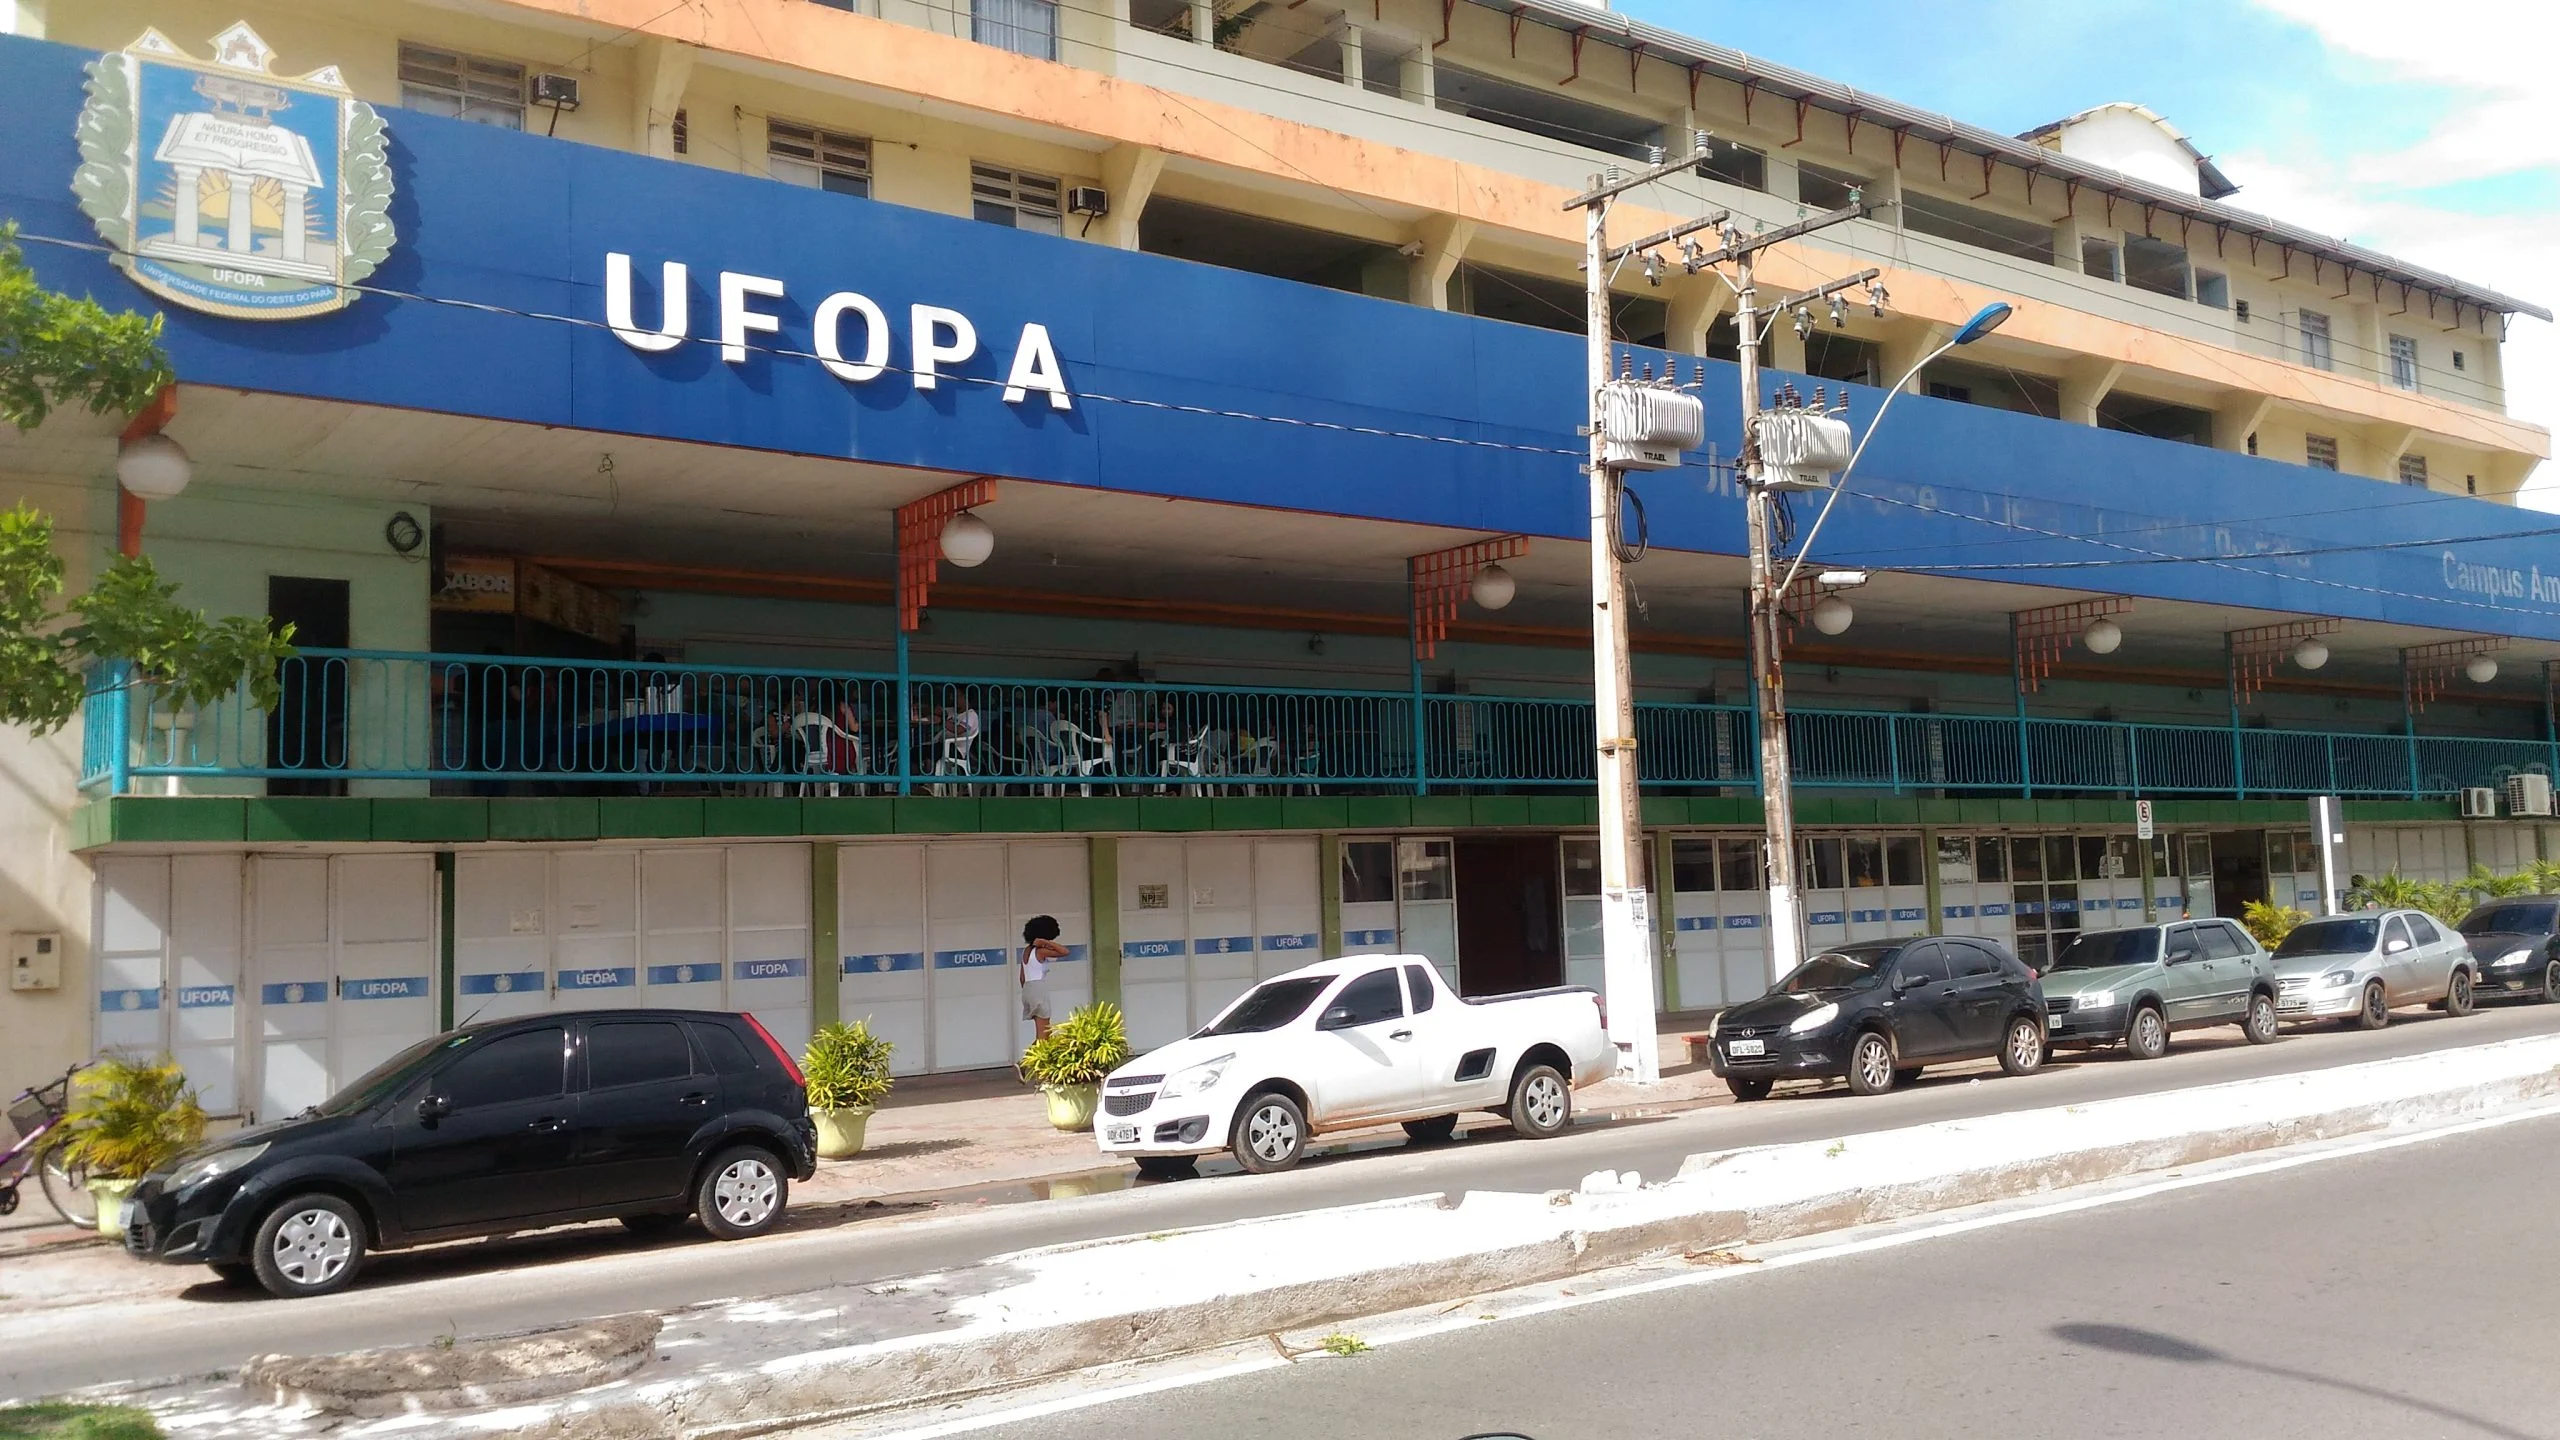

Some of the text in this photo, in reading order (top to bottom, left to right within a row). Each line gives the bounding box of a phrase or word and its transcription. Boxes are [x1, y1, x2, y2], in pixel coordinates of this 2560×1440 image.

[194, 131, 210, 143] ET
[212, 267, 265, 287] UFOPA
[208, 287, 250, 304] FEDERAL
[606, 251, 1073, 411] UFOPA
[1643, 451, 1667, 462] TRAEL
[1799, 474, 1820, 483] TRAEL
[2442, 550, 2524, 604] Campus
[1899, 910, 1917, 919] UFOPA
[1986, 906, 2003, 914] UFOPA
[1732, 918, 1752, 927] UFOPA
[1817, 914, 1836, 922] UFOPA
[1276, 937, 1303, 947] UFOPA
[1139, 943, 1170, 955] UFOPA
[954, 952, 987, 964] UFOPA
[750, 963, 789, 976] UFOPA
[576, 972, 618, 985] UFOPA
[362, 982, 409, 996] UFOPA
[180, 989, 231, 1004] UFOPA
